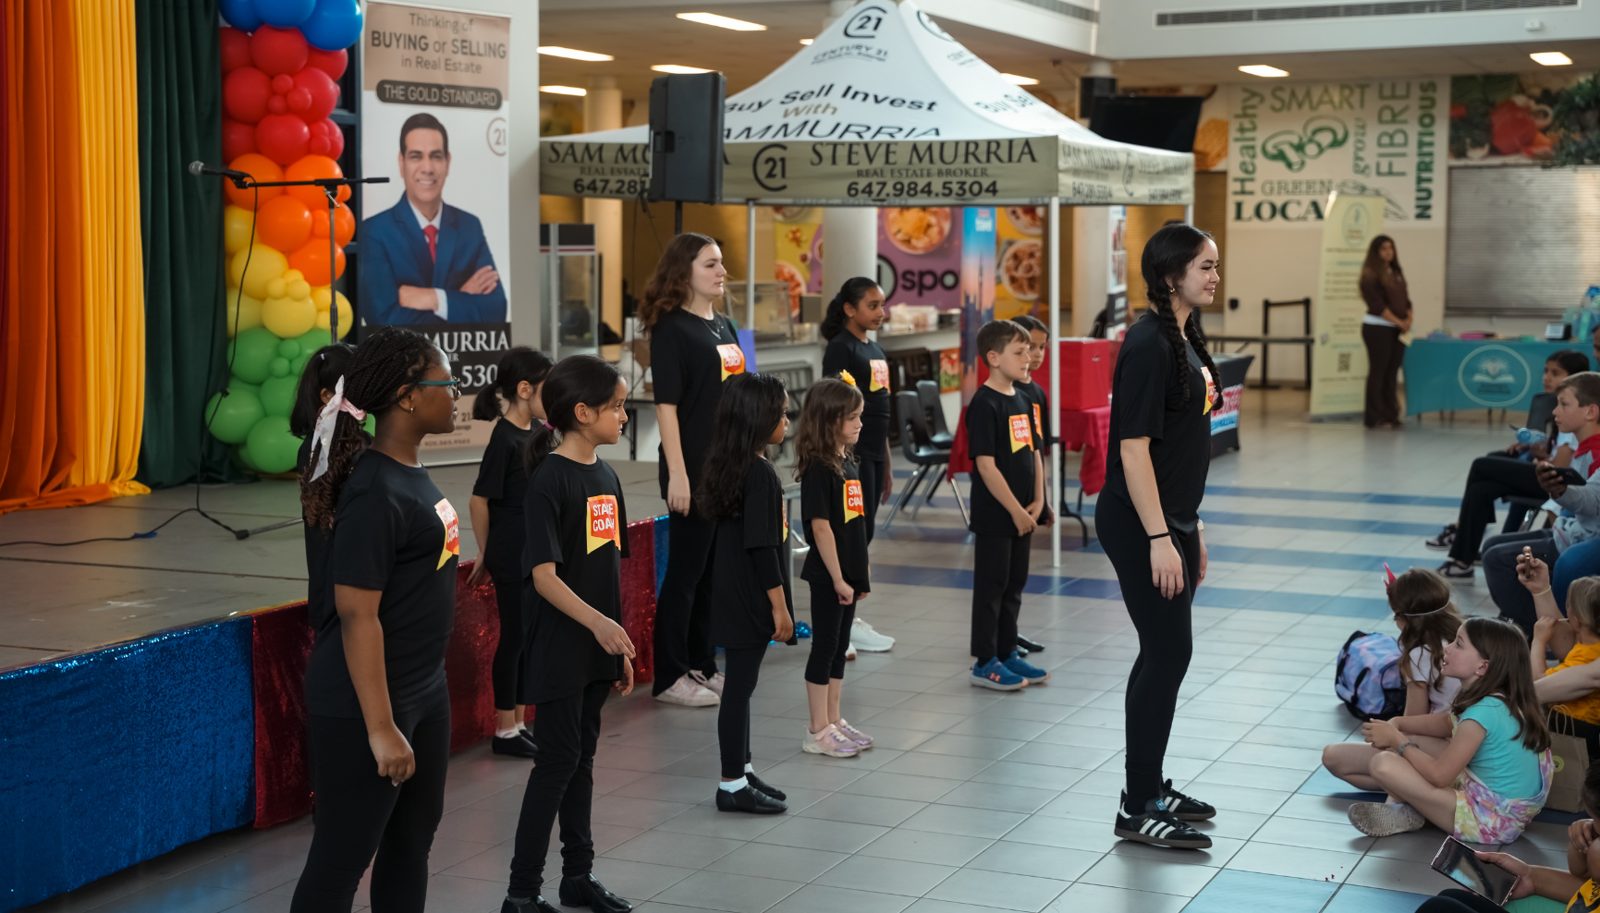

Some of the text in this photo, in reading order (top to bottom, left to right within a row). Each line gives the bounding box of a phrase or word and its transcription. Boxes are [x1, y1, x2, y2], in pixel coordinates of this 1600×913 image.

[410, 13, 475, 34] Thinking of
[371, 30, 507, 59] BUYING or SELLING
[401, 56, 482, 74] in Real Estate
[383, 84, 498, 106] THE GOLD STANDARD
[779, 83, 835, 104] Sell
[841, 85, 938, 112] Invest
[1270, 84, 1369, 113] SMART
[783, 102, 838, 118] With
[1376, 80, 1410, 176] FIBRE
[810, 140, 899, 166] STEVE
[908, 139, 1038, 166] MURRIA
[1232, 88, 1264, 195] Healthy
[1414, 81, 1436, 220] NUTRITIOUS
[547, 142, 605, 164] SAM
[857, 168, 989, 180] REAL ESTATE BROKER
[847, 180, 999, 199] 647.984.5304
[1261, 180, 1333, 196] GREEN
[1234, 200, 1326, 222] LOCA
